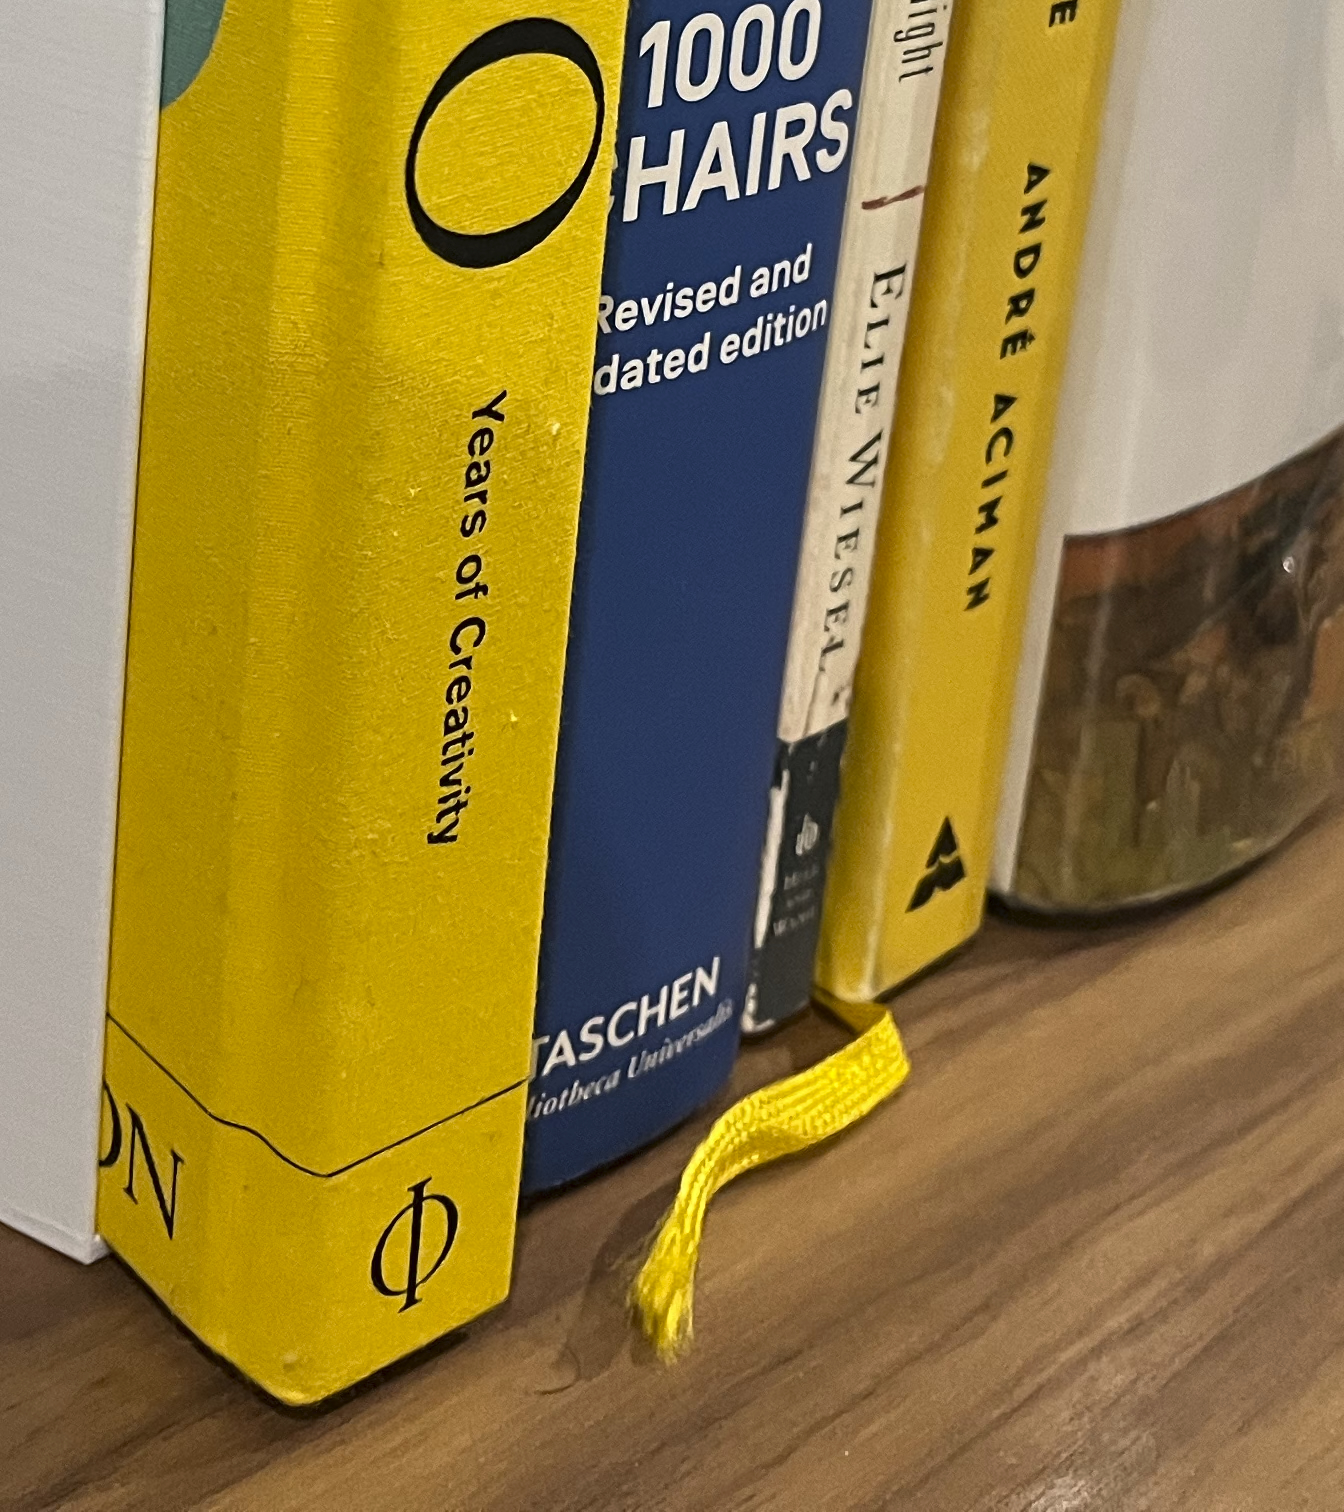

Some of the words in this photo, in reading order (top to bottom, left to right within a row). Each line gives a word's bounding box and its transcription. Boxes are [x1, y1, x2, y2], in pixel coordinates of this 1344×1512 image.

[610, 88, 854, 223] HAIRS
[597, 264, 742, 335] Revised
[749, 242, 813, 299] and
[999, 161, 1051, 360] ANDRÉ
[593, 331, 711, 396] dated
[719, 299, 827, 365] edition
[854, 262, 908, 416] ELIE
[459, 389, 508, 539] Years
[963, 393, 1018, 612] ACIMAN
[454, 553, 490, 601] of
[817, 426, 885, 673] WIESEL
[426, 615, 487, 846] Creativity
[528, 956, 721, 1083] TASCHEN
